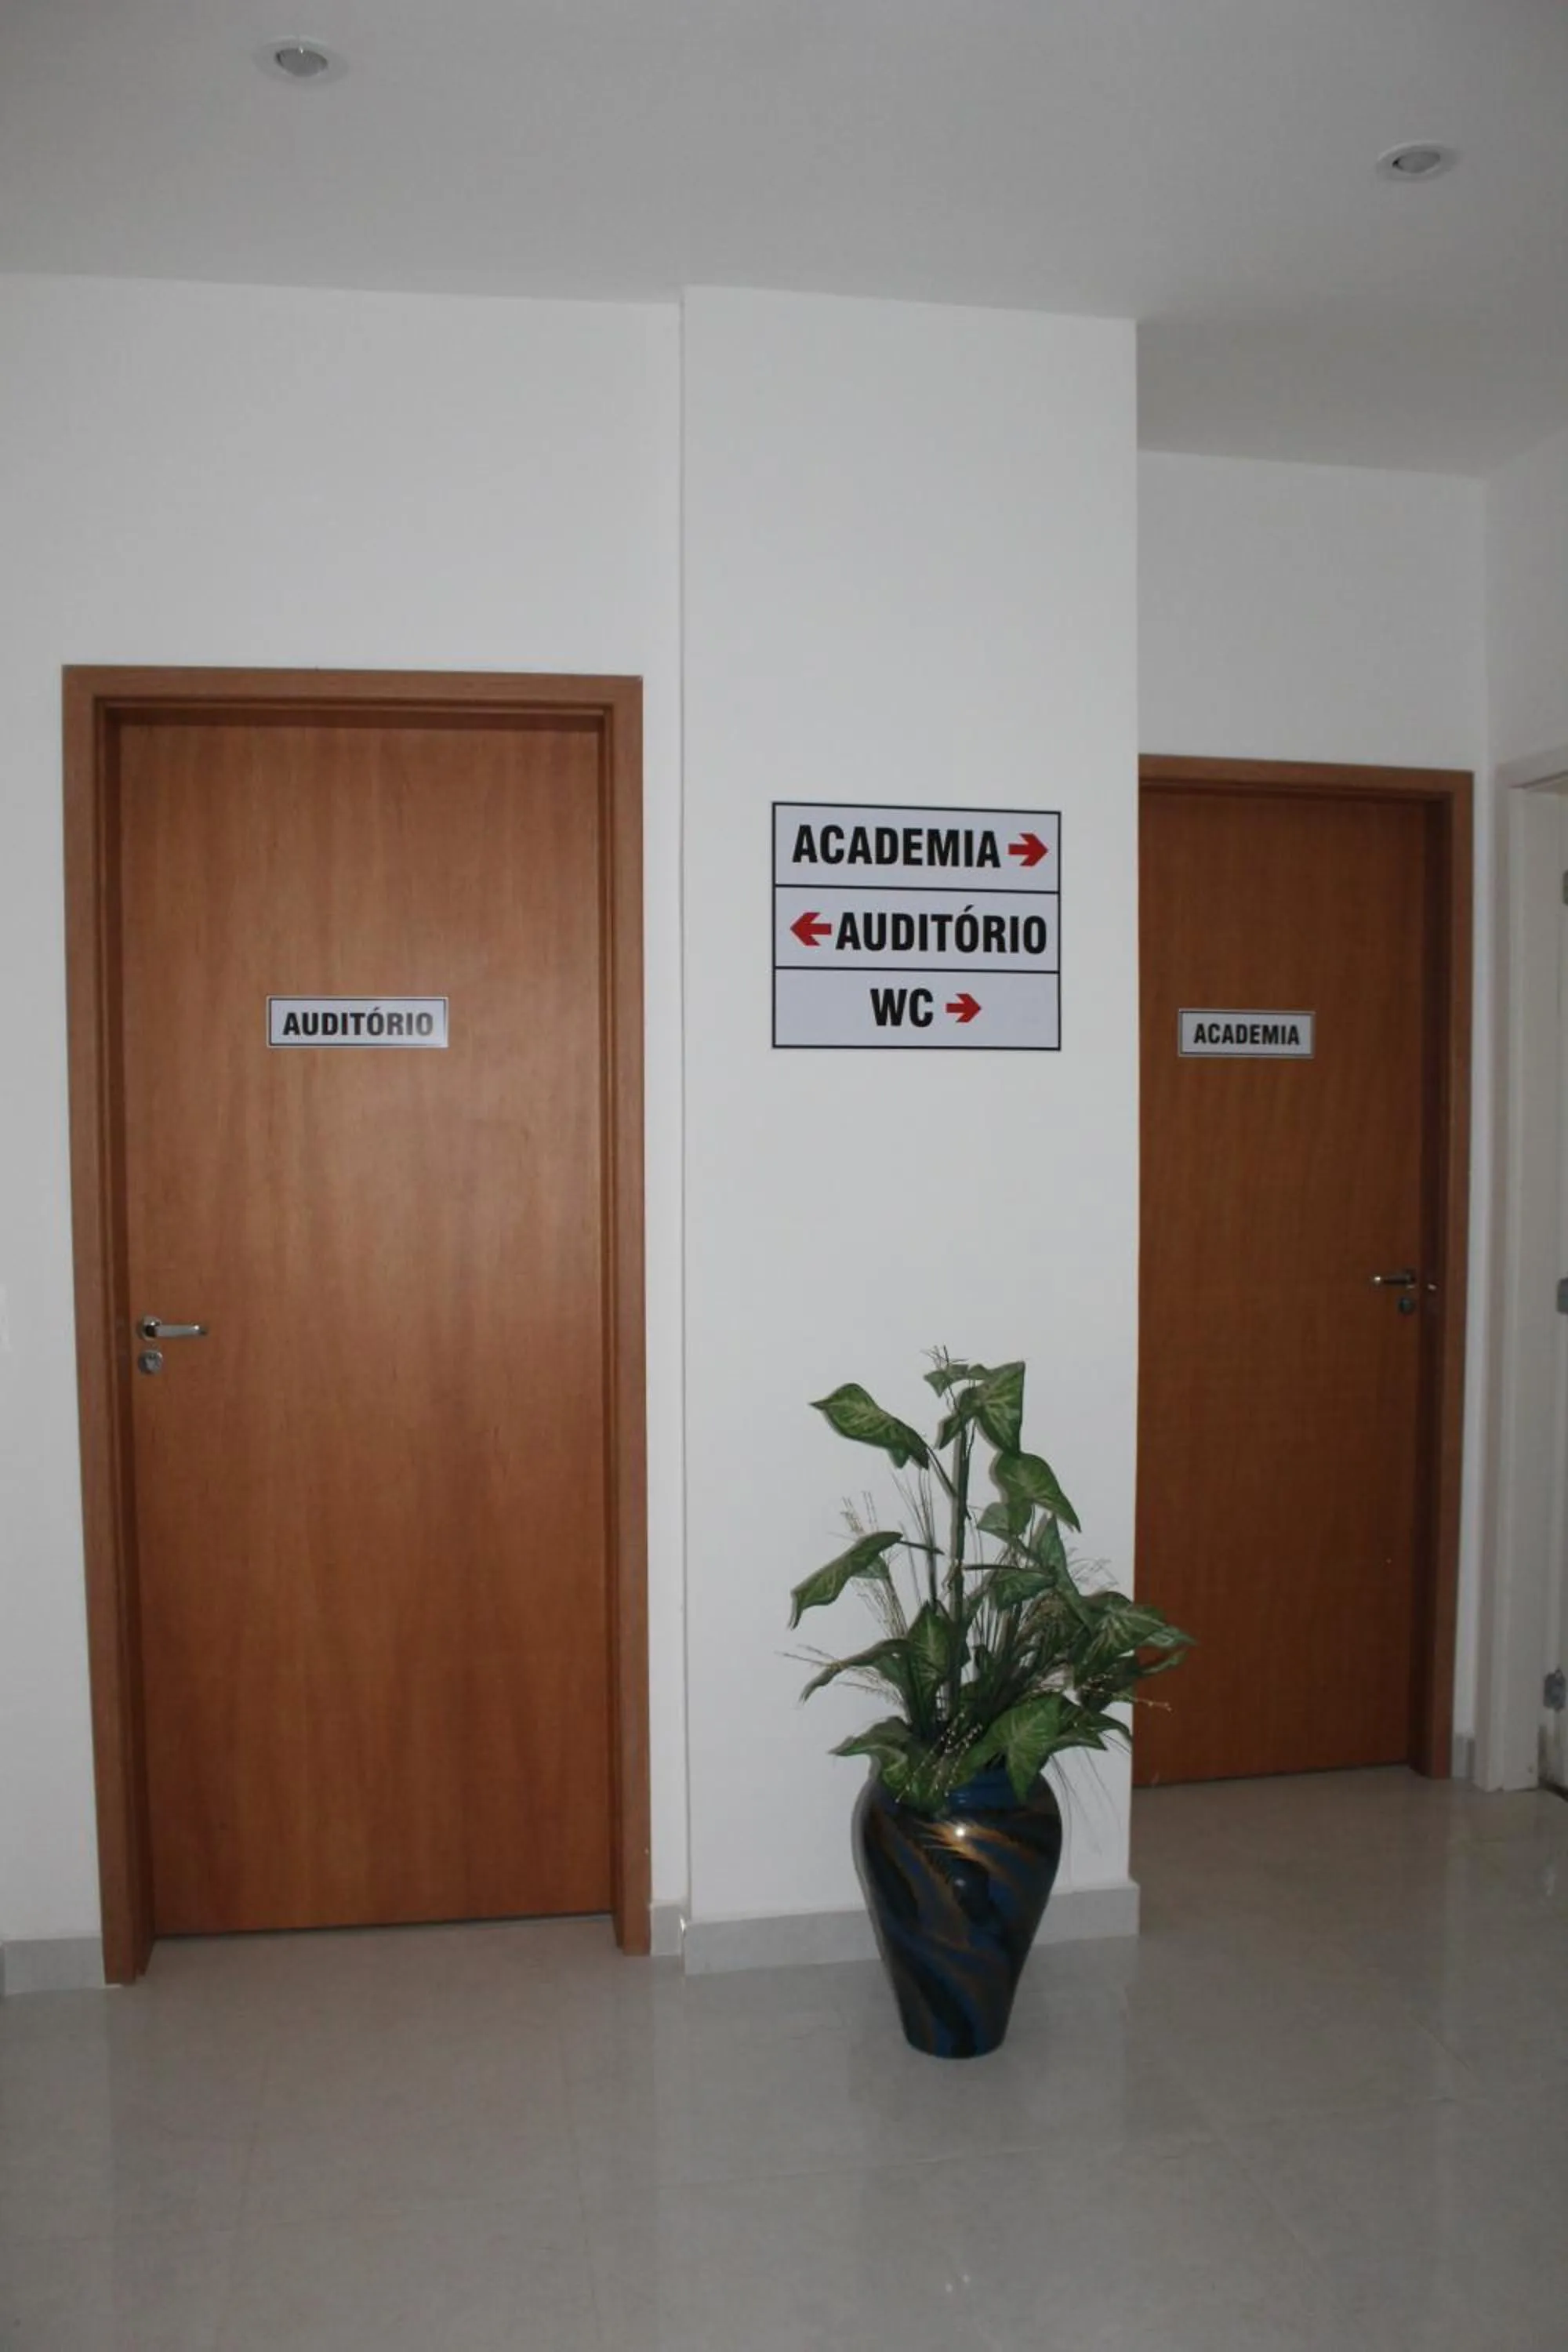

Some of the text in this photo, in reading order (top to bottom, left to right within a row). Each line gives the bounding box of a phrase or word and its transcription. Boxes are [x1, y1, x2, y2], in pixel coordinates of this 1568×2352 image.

[792, 824, 1001, 868] ACADEMIA
[835, 904, 1047, 954] AUDITÓRIO
[282, 1007, 434, 1036] AUDITÓRIO
[869, 988, 934, 1028] WC
[1193, 1022, 1301, 1046] ACADEMIA
